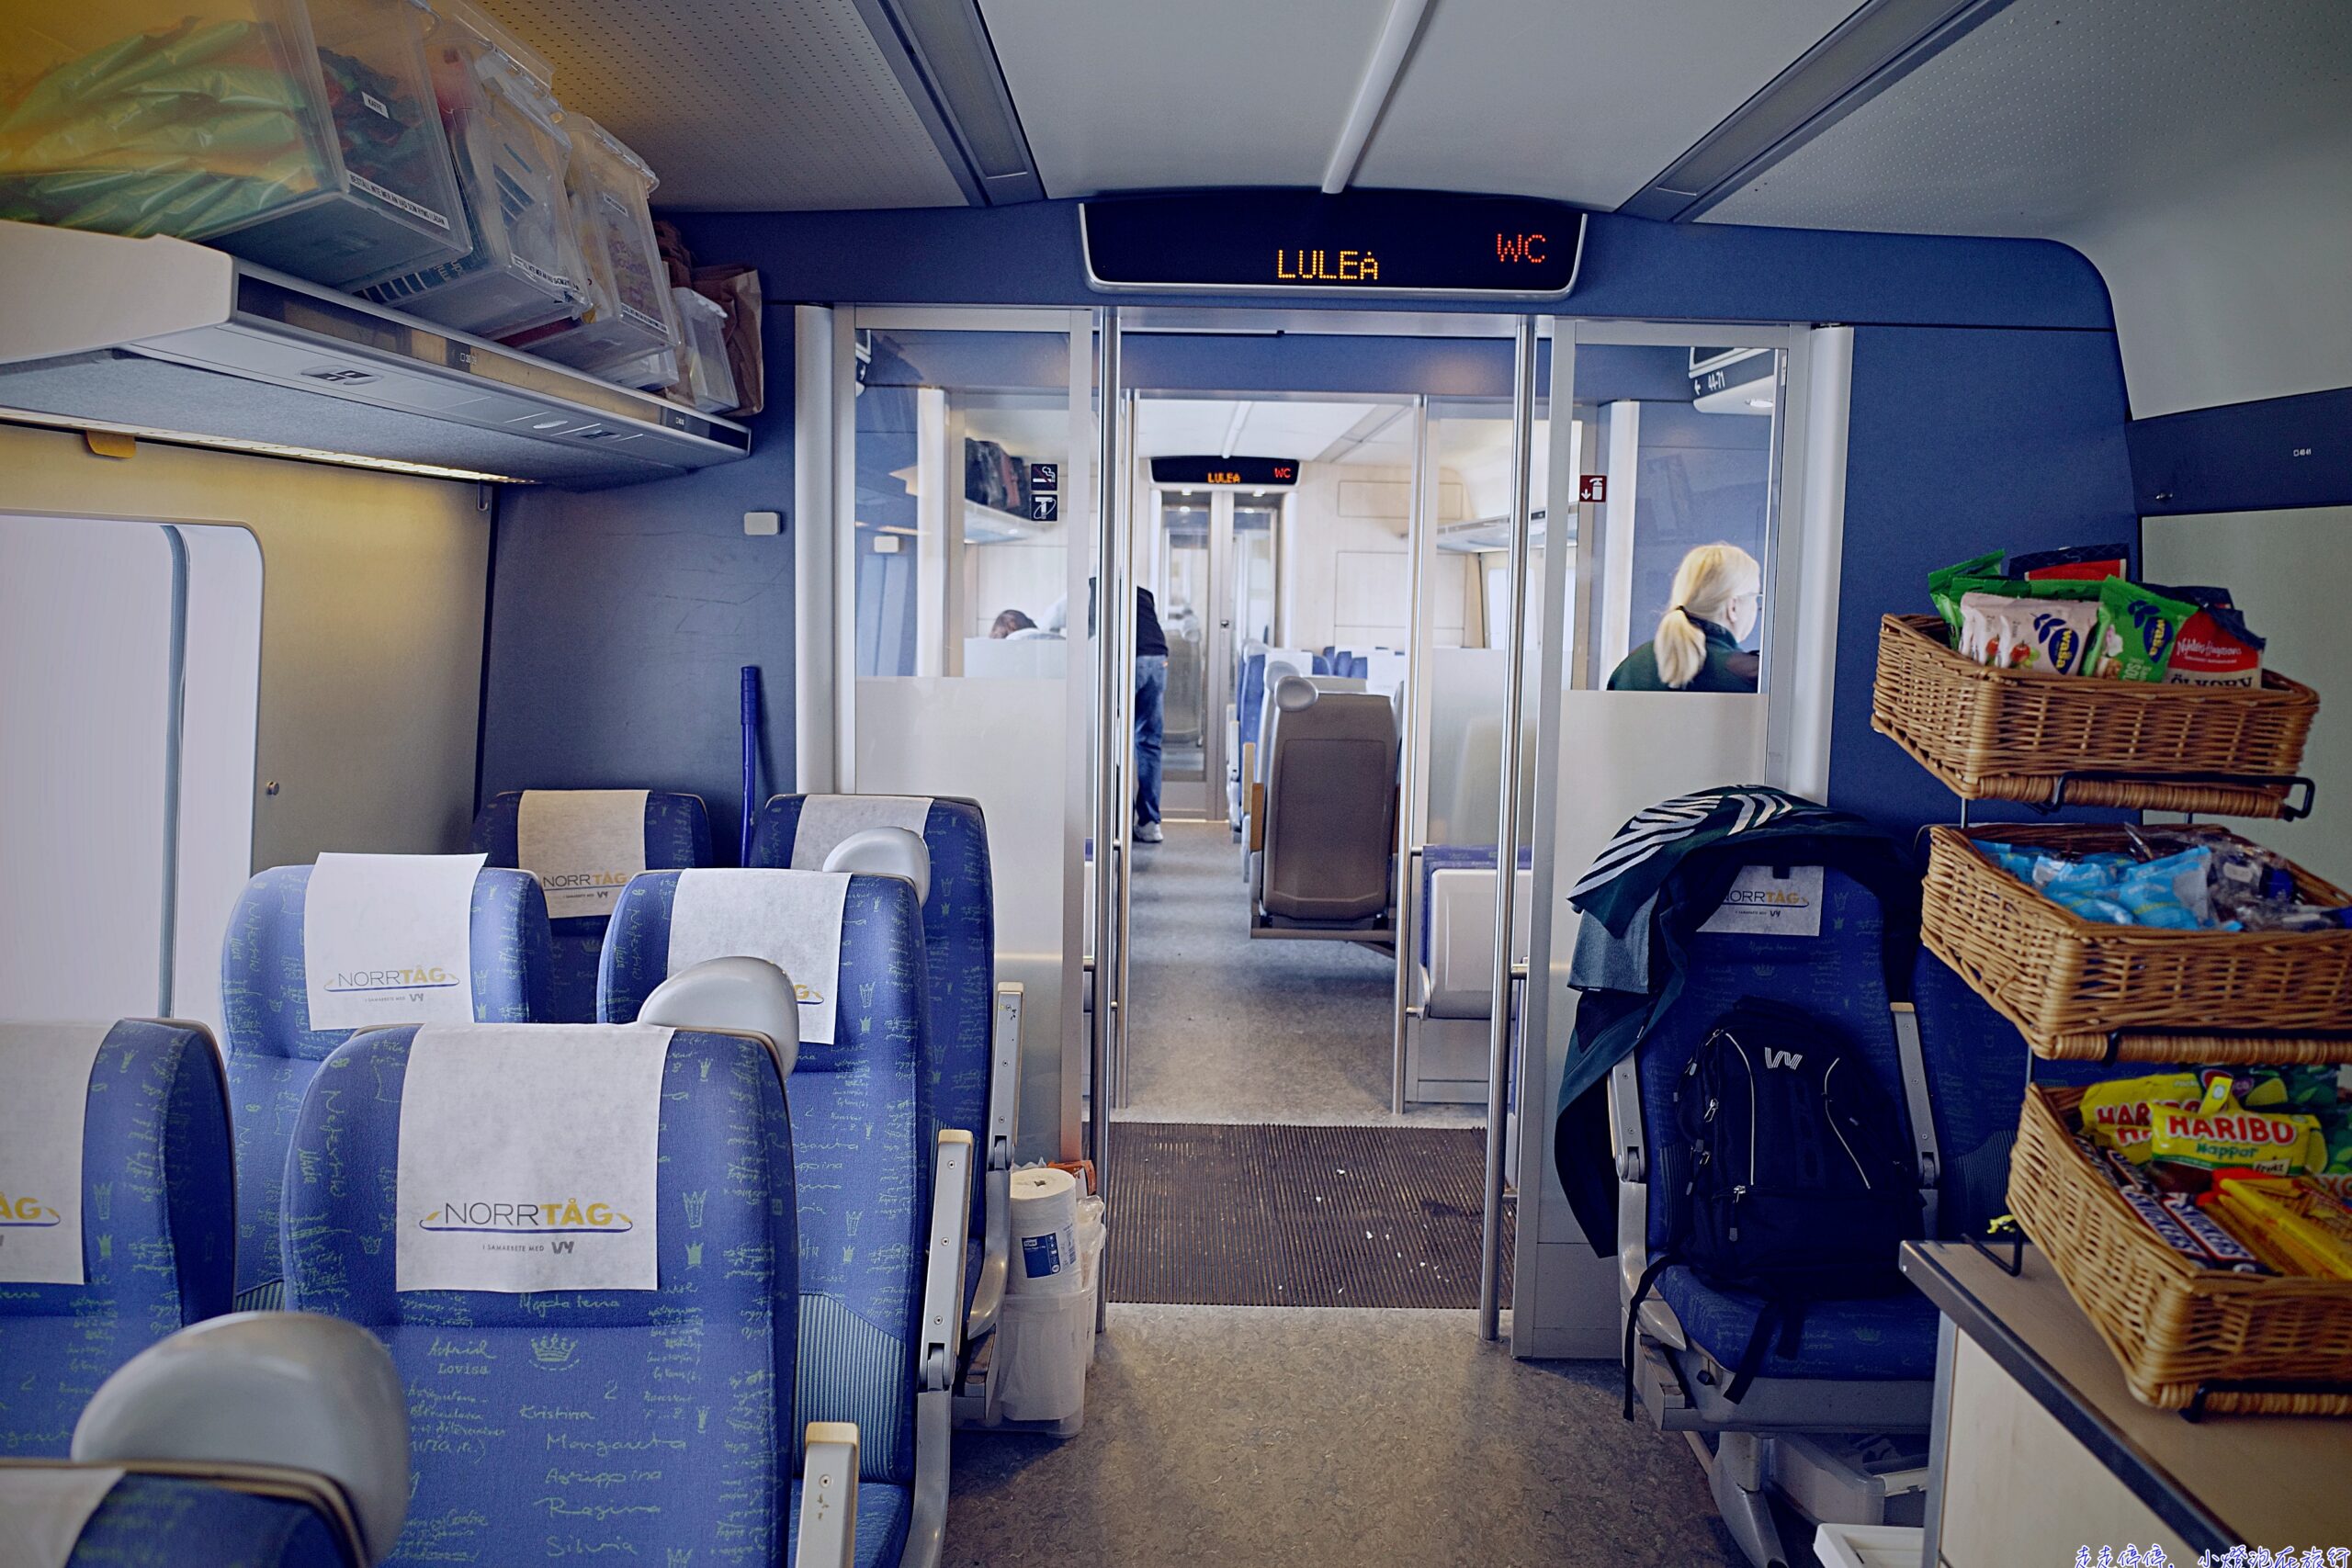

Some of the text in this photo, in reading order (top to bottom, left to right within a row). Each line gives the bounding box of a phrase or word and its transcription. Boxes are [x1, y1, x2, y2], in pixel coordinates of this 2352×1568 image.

[1496, 232, 1547, 265] WC
[1274, 468, 1291, 479] WC
[543, 869, 628, 887] NORRTÅG
[1725, 889, 1800, 904] ORRTÅG
[338, 964, 447, 987] NORRTÅG
[2168, 1115, 2296, 1145] HARIBO
[445, 1196, 615, 1227] NORRTÅG
[487, 1244, 526, 1252] SAMARBETE
[529, 1244, 545, 1252] MED
